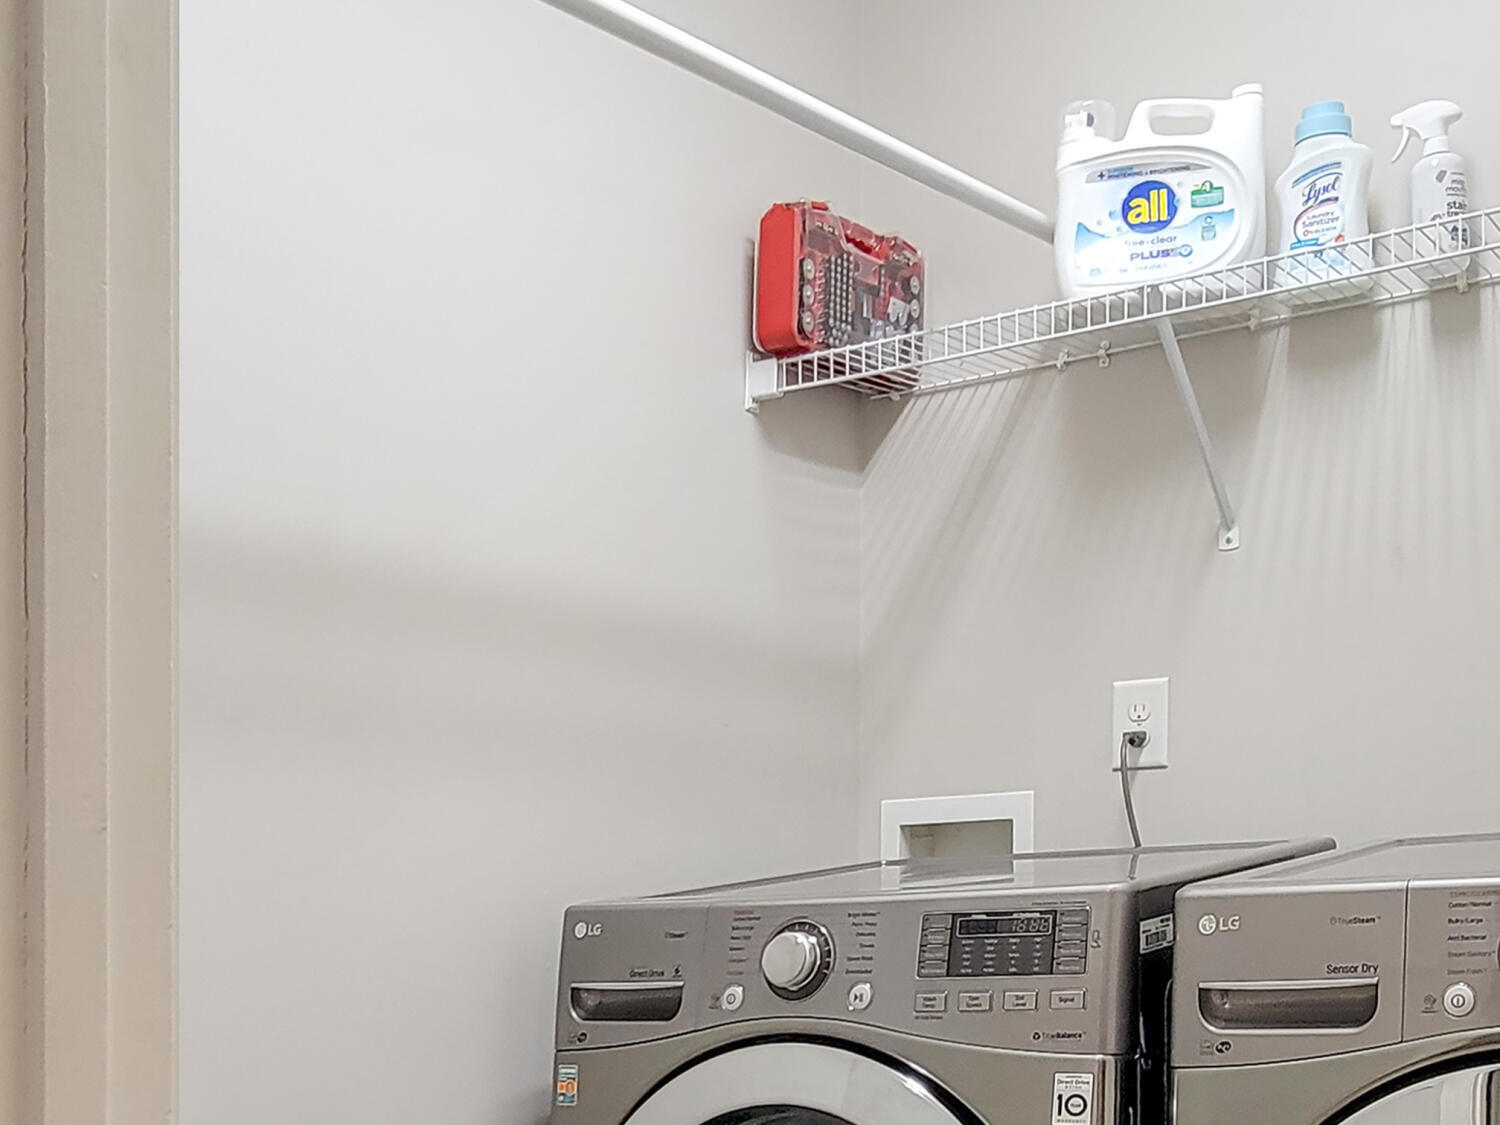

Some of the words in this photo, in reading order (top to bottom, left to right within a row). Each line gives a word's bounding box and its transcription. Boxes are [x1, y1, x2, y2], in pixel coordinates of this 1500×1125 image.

[1301, 175, 1340, 207] Lysol
[1127, 188, 1169, 225] all
[1150, 235, 1177, 245] clear
[587, 922, 603, 936] LG
[1219, 915, 1240, 931] LG
[1326, 963, 1359, 975] Sensor
[1361, 962, 1379, 975] Dry
[1057, 1093, 1088, 1117] 10
